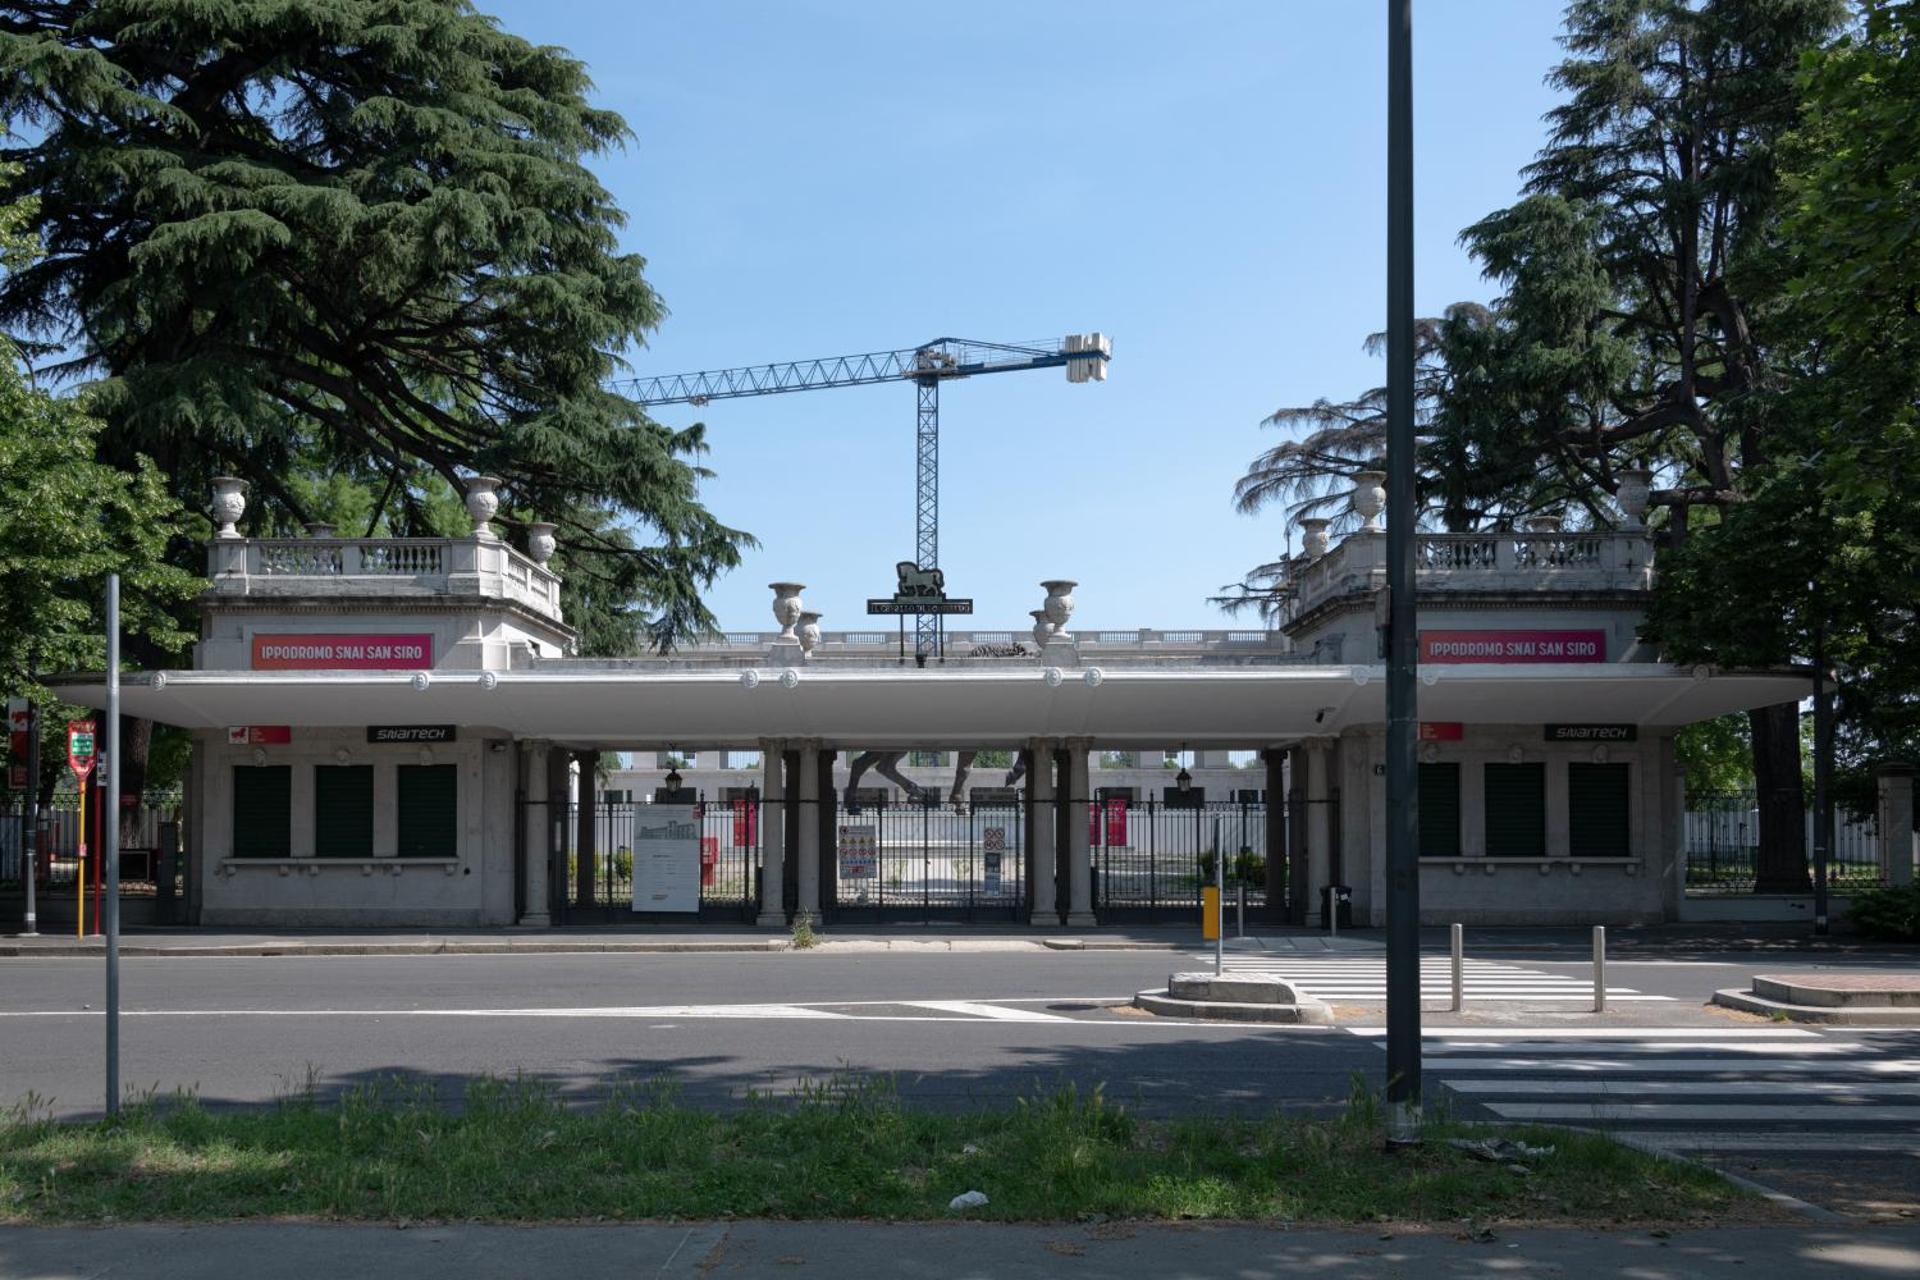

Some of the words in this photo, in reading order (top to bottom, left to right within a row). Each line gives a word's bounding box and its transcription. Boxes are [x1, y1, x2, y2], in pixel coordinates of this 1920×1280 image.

[261, 646, 334, 660] IPPODROMO
[335, 646, 364, 660] SNAI
[367, 646, 392, 660] SAN
[394, 646, 423, 660] SIRO
[1430, 642, 1504, 656] IPPODROMO
[1506, 642, 1536, 656] SNAI
[1539, 642, 1564, 656] SAN
[1566, 642, 1597, 656] SIRO
